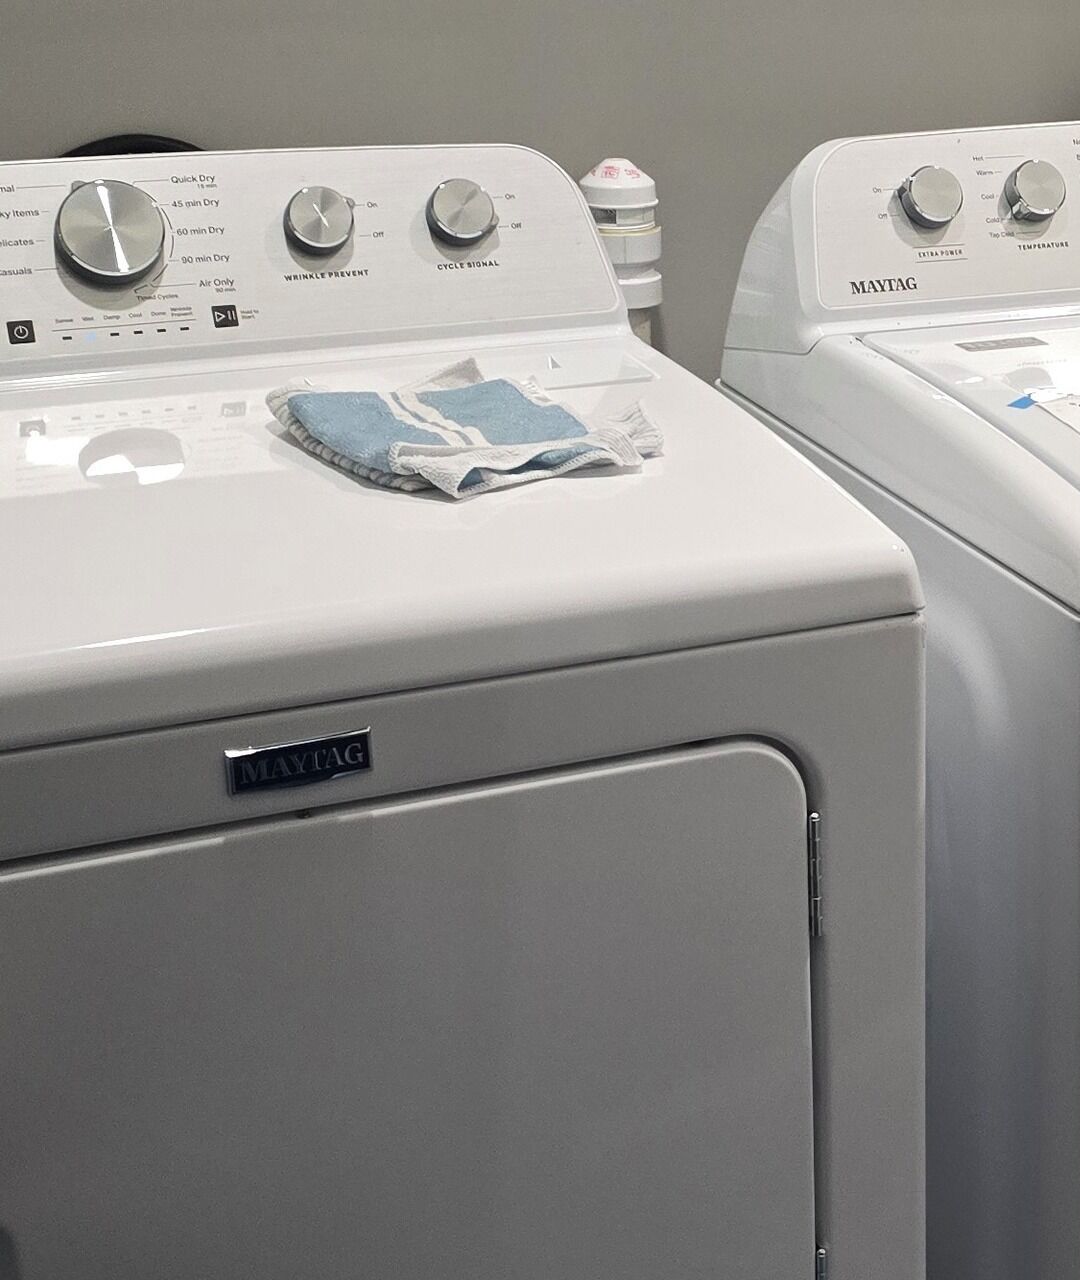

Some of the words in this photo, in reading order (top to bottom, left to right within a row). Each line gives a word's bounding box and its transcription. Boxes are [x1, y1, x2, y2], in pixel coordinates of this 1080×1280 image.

[171, 175, 198, 184] Quick
[199, 174, 215, 183] Dry
[505, 192, 516, 200] On
[172, 200, 183, 208] 45
[185, 199, 201, 208] min
[203, 198, 219, 207] Dry
[12, 209, 40, 217] Items
[177, 228, 188, 236] 60
[190, 227, 206, 235] min
[208, 226, 224, 234] Dry
[1018, 241, 1069, 251] TEMPERATURE
[181, 256, 192, 264] 90
[195, 255, 212, 263] min
[213, 254, 230, 263] Dry
[437, 262, 465, 270] CYCLE
[467, 260, 499, 268] SIGNAL
[284, 272, 326, 281] WRINKLE
[328, 270, 369, 279] PREVENT
[199, 280, 211, 288] Air
[213, 278, 234, 287] Only
[850, 277, 917, 294] MAYTAG
[240, 743, 364, 784] MAYTAG
